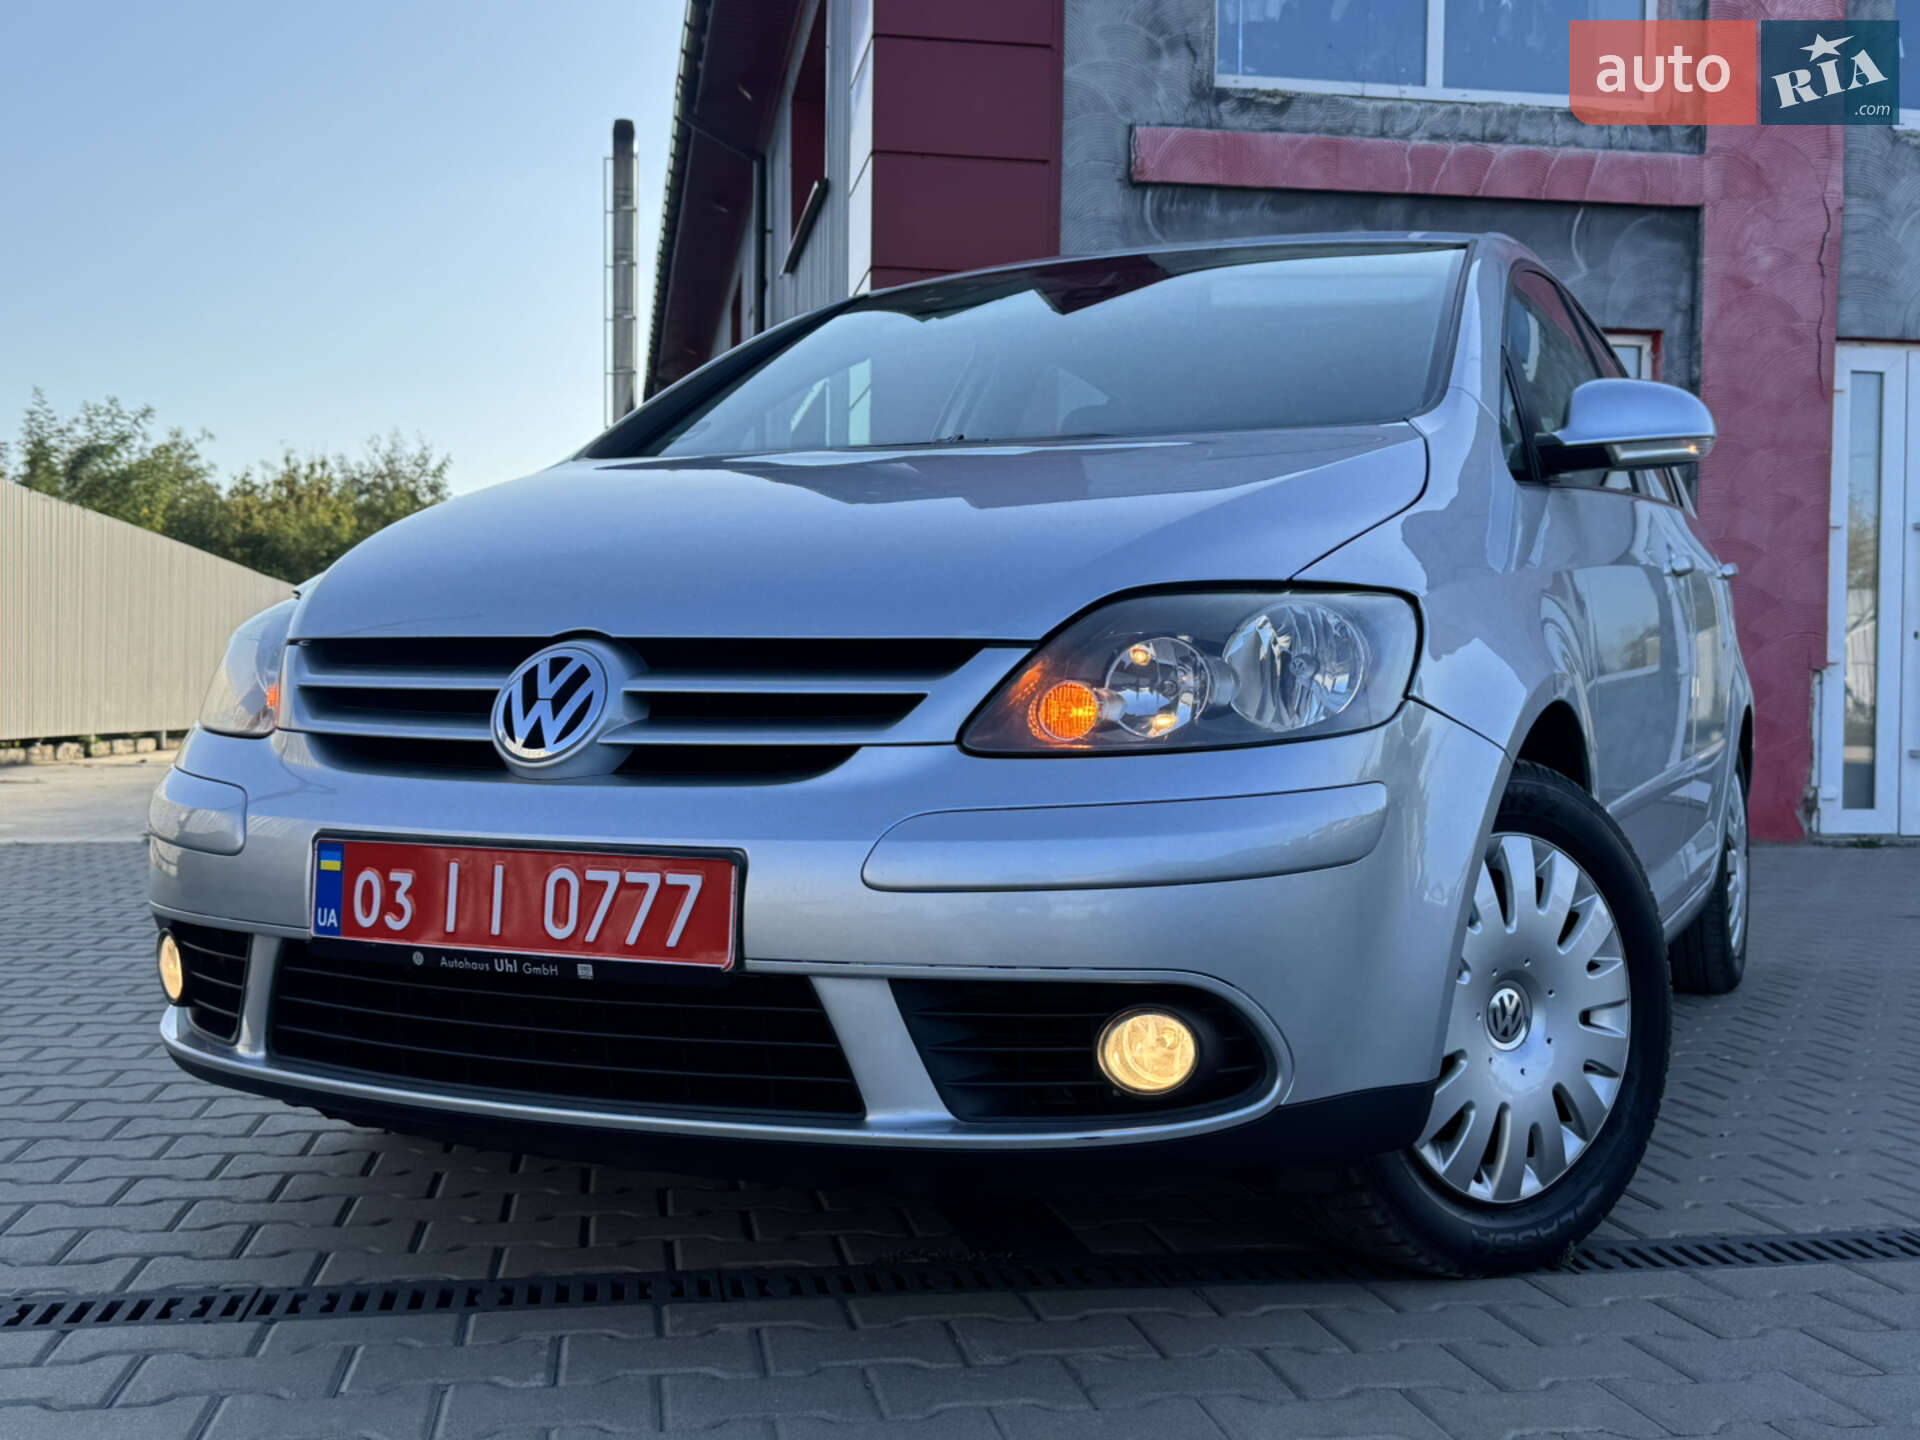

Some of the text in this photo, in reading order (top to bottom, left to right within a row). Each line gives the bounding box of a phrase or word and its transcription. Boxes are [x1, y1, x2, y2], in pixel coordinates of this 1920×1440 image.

[317, 906, 338, 927] UA
[353, 870, 413, 931] 03
[543, 867, 703, 948] 0777
[439, 955, 490, 972] Autohaus
[493, 958, 518, 974] Uhl
[522, 962, 559, 977] GmbH
